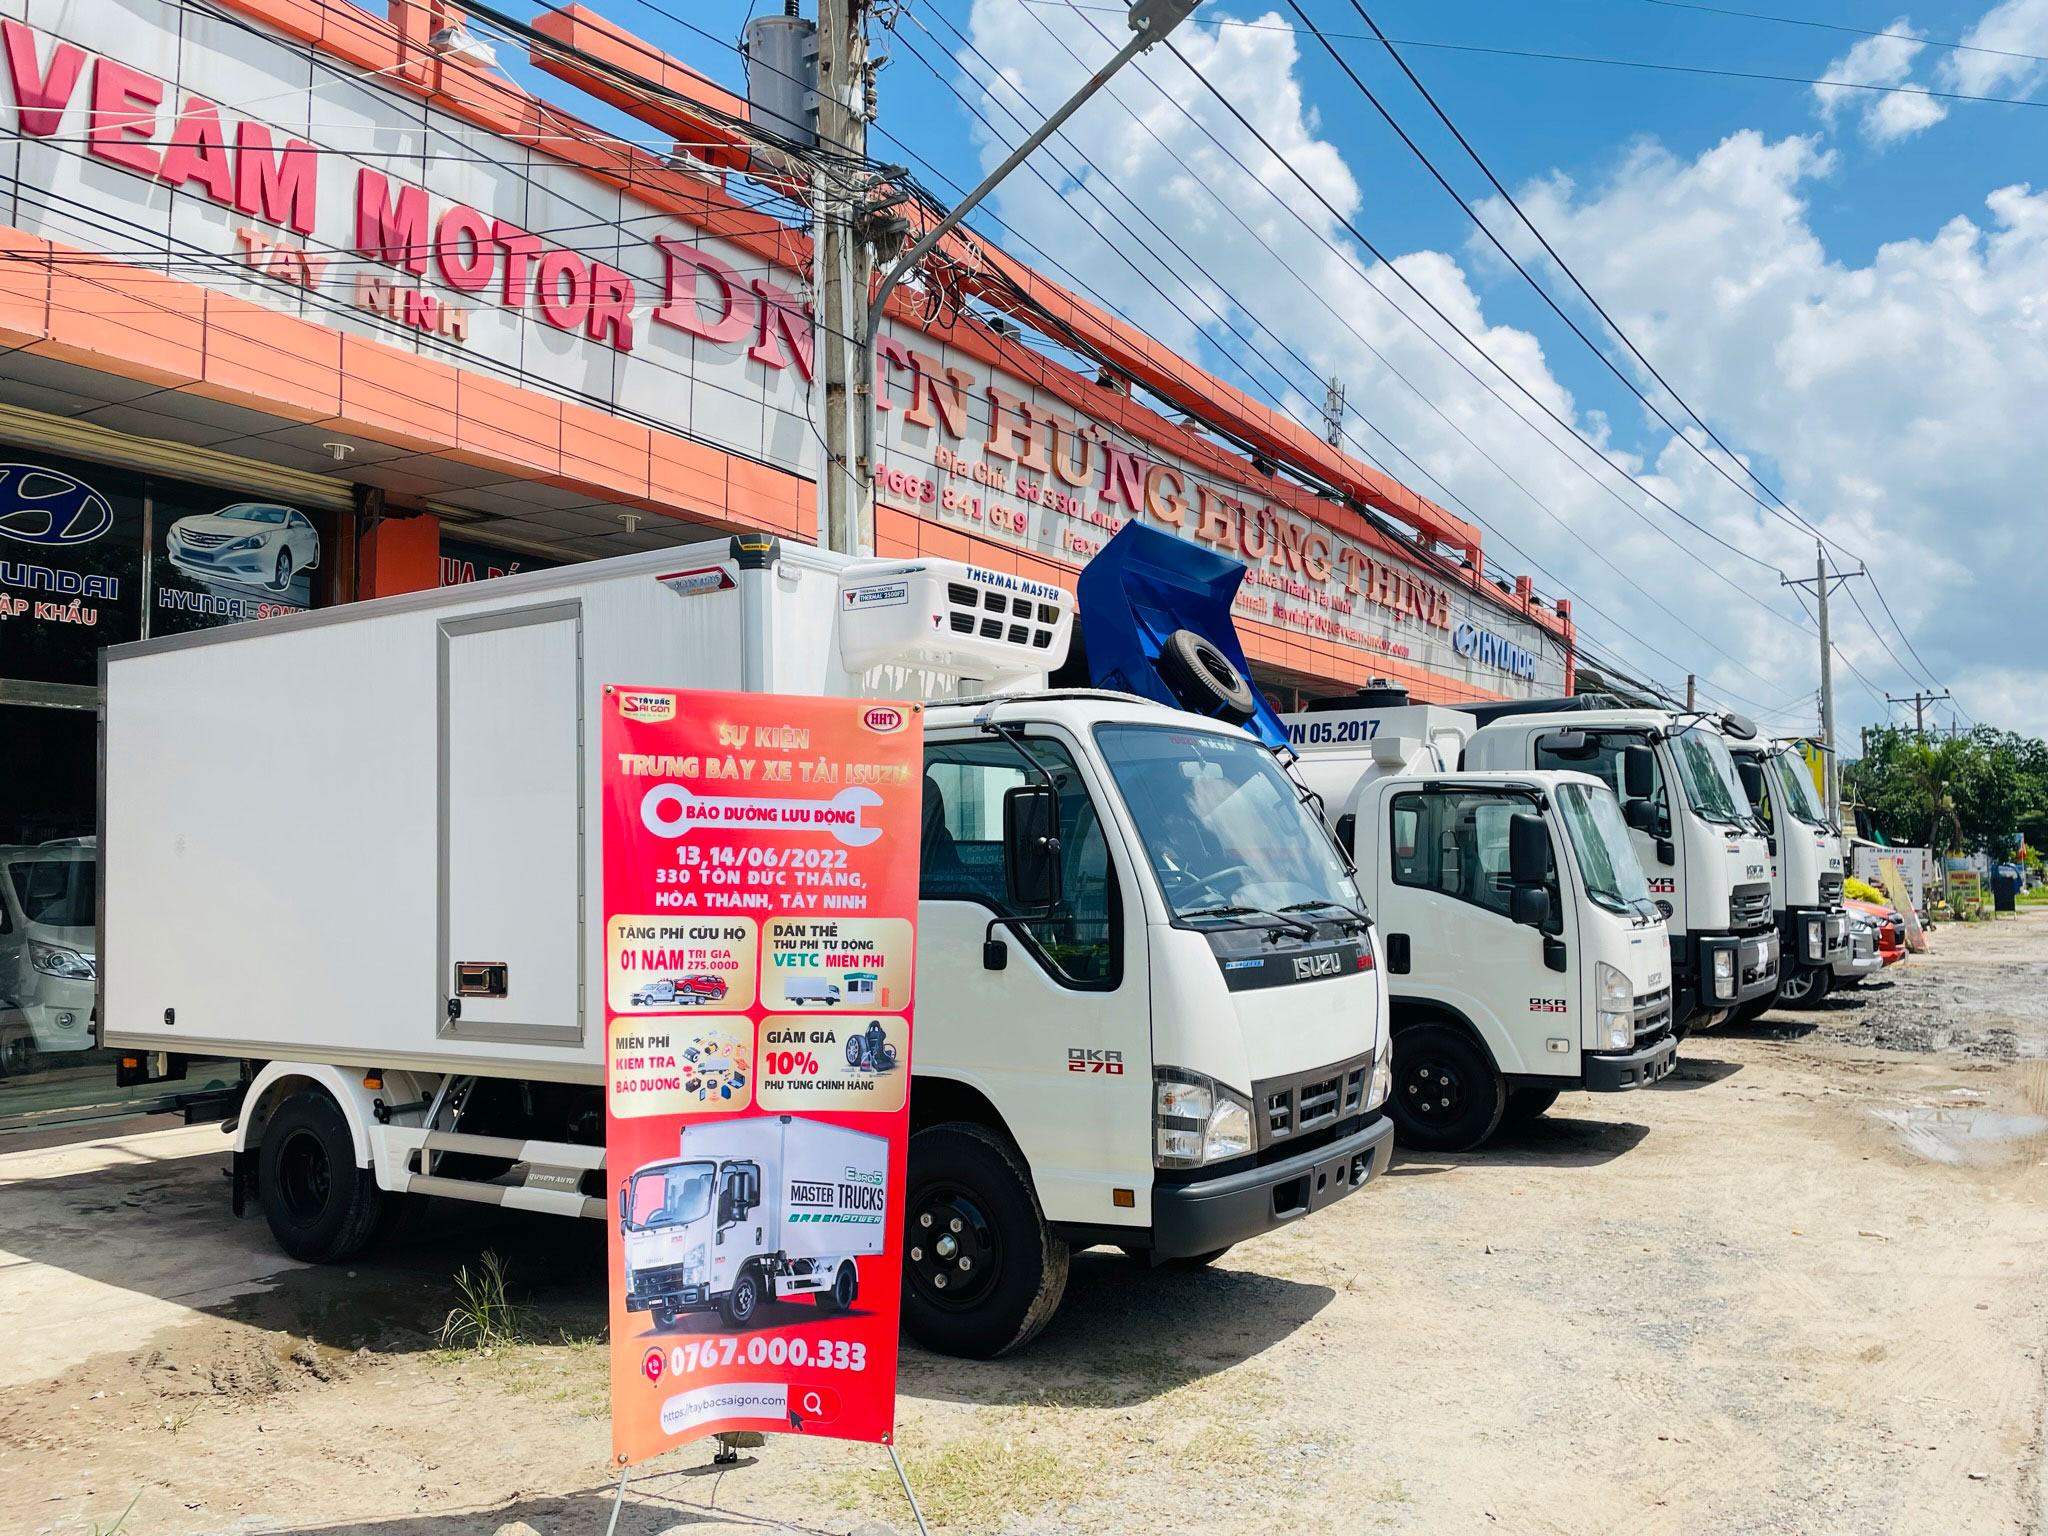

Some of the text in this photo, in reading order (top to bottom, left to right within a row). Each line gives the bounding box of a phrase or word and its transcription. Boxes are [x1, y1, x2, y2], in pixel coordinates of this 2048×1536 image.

[2, 19, 637, 352] VEAM MOTOR
[355, 271, 469, 342] NINH
[943, 486, 983, 520] 841
[989, 504, 1028, 534] 619
[1043, 487, 1080, 516] 330
[0, 560, 119, 601] UNDAI
[439, 556, 476, 587] UA
[965, 566, 1060, 601] THERMAL MASTER
[34, 597, 98, 626] KHẨU
[158, 587, 248, 619] HYUNDAI
[870, 712, 895, 726] HHT
[1309, 719, 1381, 744] 05.2017
[718, 725, 749, 751] SỰ
[761, 760, 793, 782] XE
[676, 846, 849, 870] 13,14/06/2022
[655, 869, 690, 884] 330
[699, 868, 741, 885] TÔN
[824, 893, 868, 910] NINH
[773, 940, 799, 951] THU
[621, 951, 638, 971] 01
[773, 952, 820, 968] VETC
[1291, 952, 1342, 981] ISUZU
[648, 1055, 676, 1069] TRA
[766, 1051, 819, 1076] 10%
[1068, 1048, 1123, 1063] QKR
[1068, 1061, 1124, 1075] 270
[790, 1183, 885, 1211] MASTER TRUCKS
[671, 1336, 867, 1377] 0767.000.333
[662, 1394, 786, 1424] https://taybacsaigon.com
